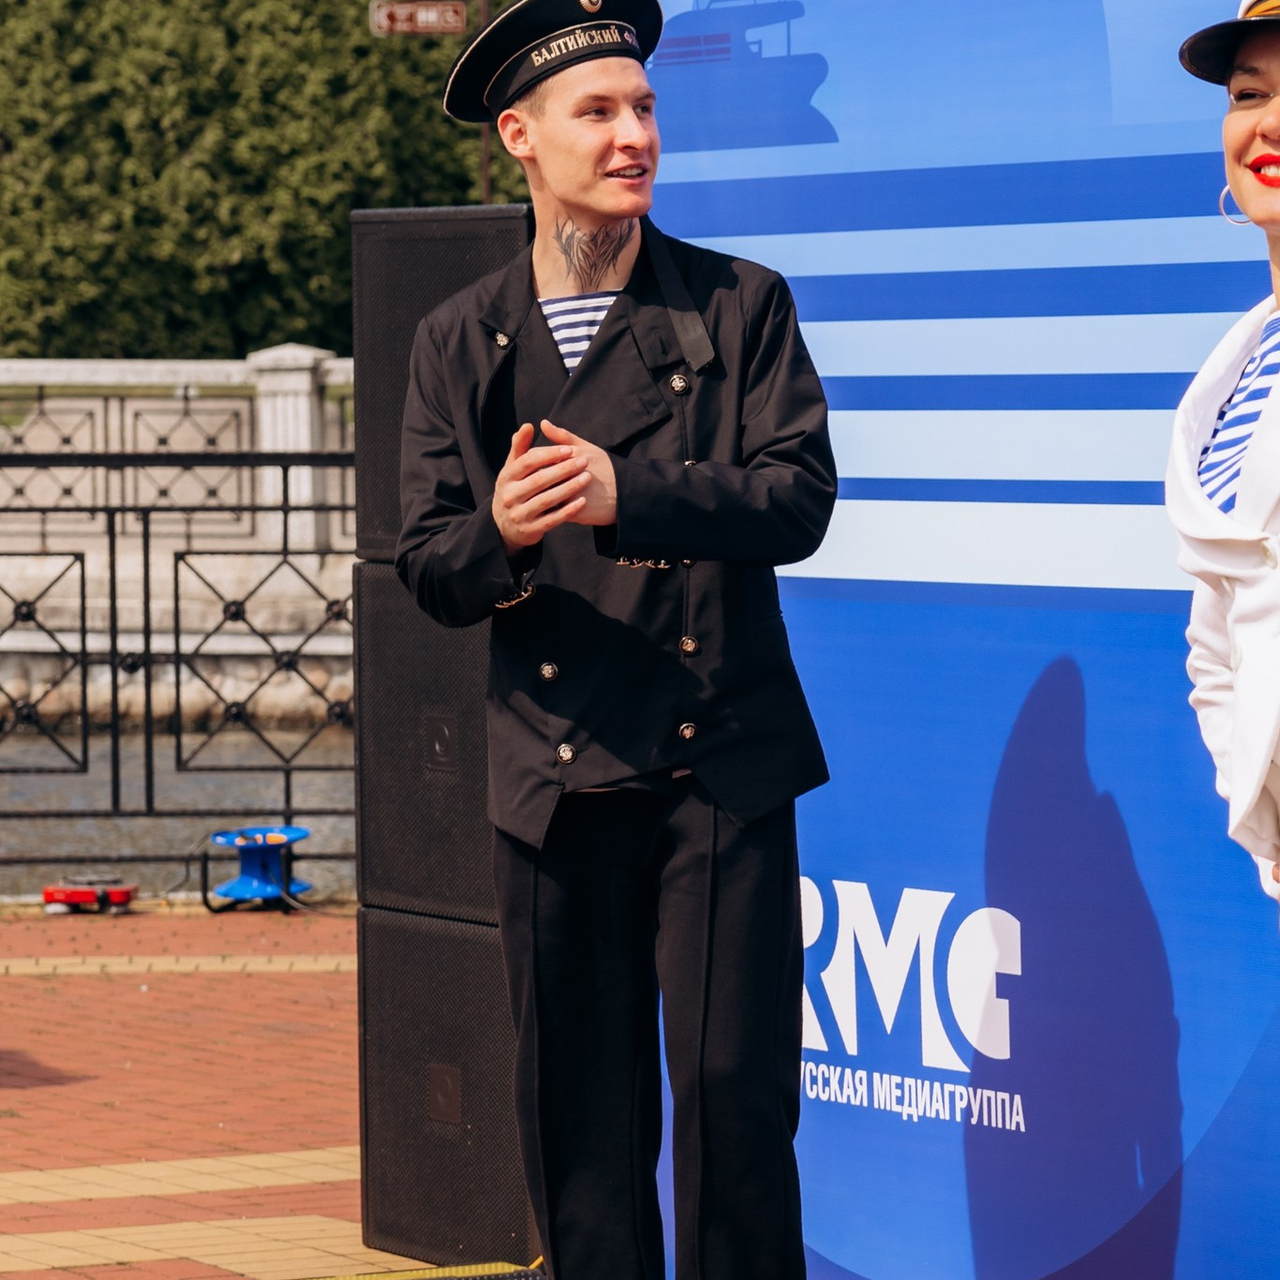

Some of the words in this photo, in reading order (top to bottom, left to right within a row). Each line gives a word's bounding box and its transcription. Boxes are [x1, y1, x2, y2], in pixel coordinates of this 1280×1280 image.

[530, 25, 621, 67] БАЛТИЙСКИЙ
[800, 1061, 868, 1108] ССКАЯ
[873, 1072, 1026, 1133] МЕДИАГРУППА
